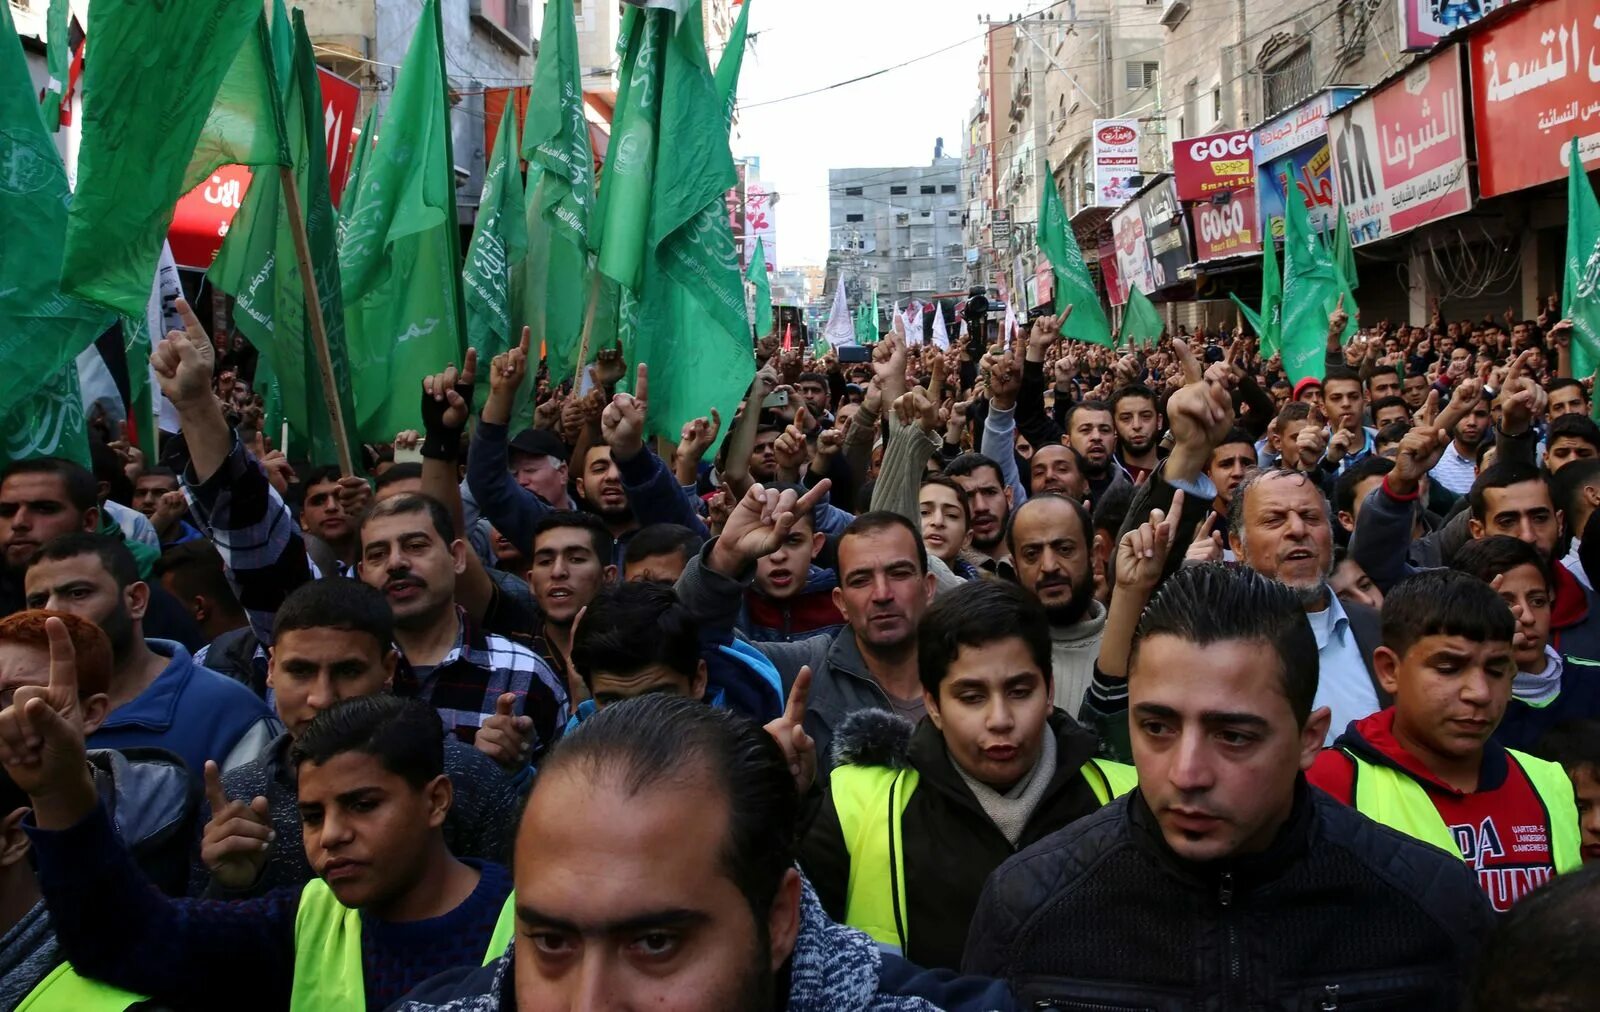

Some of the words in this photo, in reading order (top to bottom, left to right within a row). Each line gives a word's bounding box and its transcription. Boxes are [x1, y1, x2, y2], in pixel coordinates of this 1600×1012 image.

[1483, 18, 1580, 102] التسعة
[1382, 87, 1457, 170] الشرفا
[1201, 179, 1235, 192] Smart
[1200, 200, 1244, 243] GOGO
